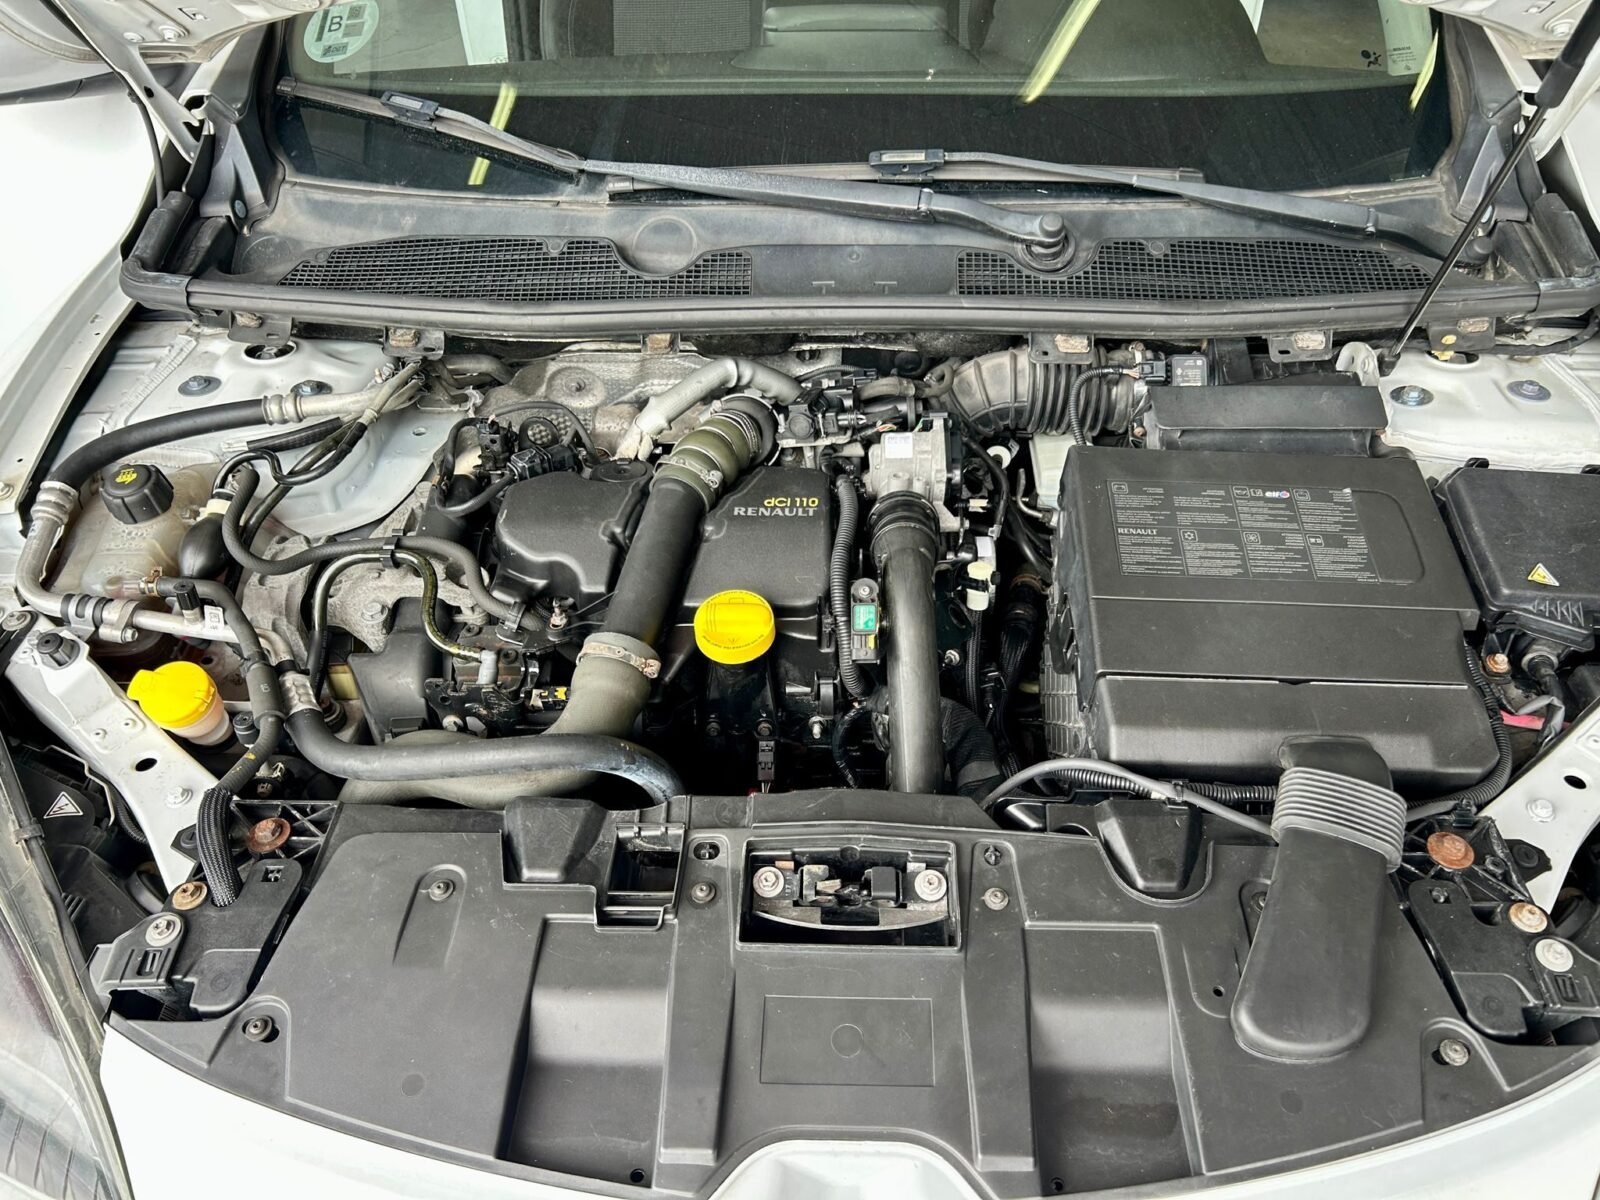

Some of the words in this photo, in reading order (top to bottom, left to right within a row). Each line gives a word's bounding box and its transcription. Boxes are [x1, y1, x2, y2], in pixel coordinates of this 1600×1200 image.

[327, 15, 343, 33] B
[795, 497, 819, 507] 110
[733, 506, 818, 517] RENAULT
[1117, 527, 1158, 535] RENAULT
